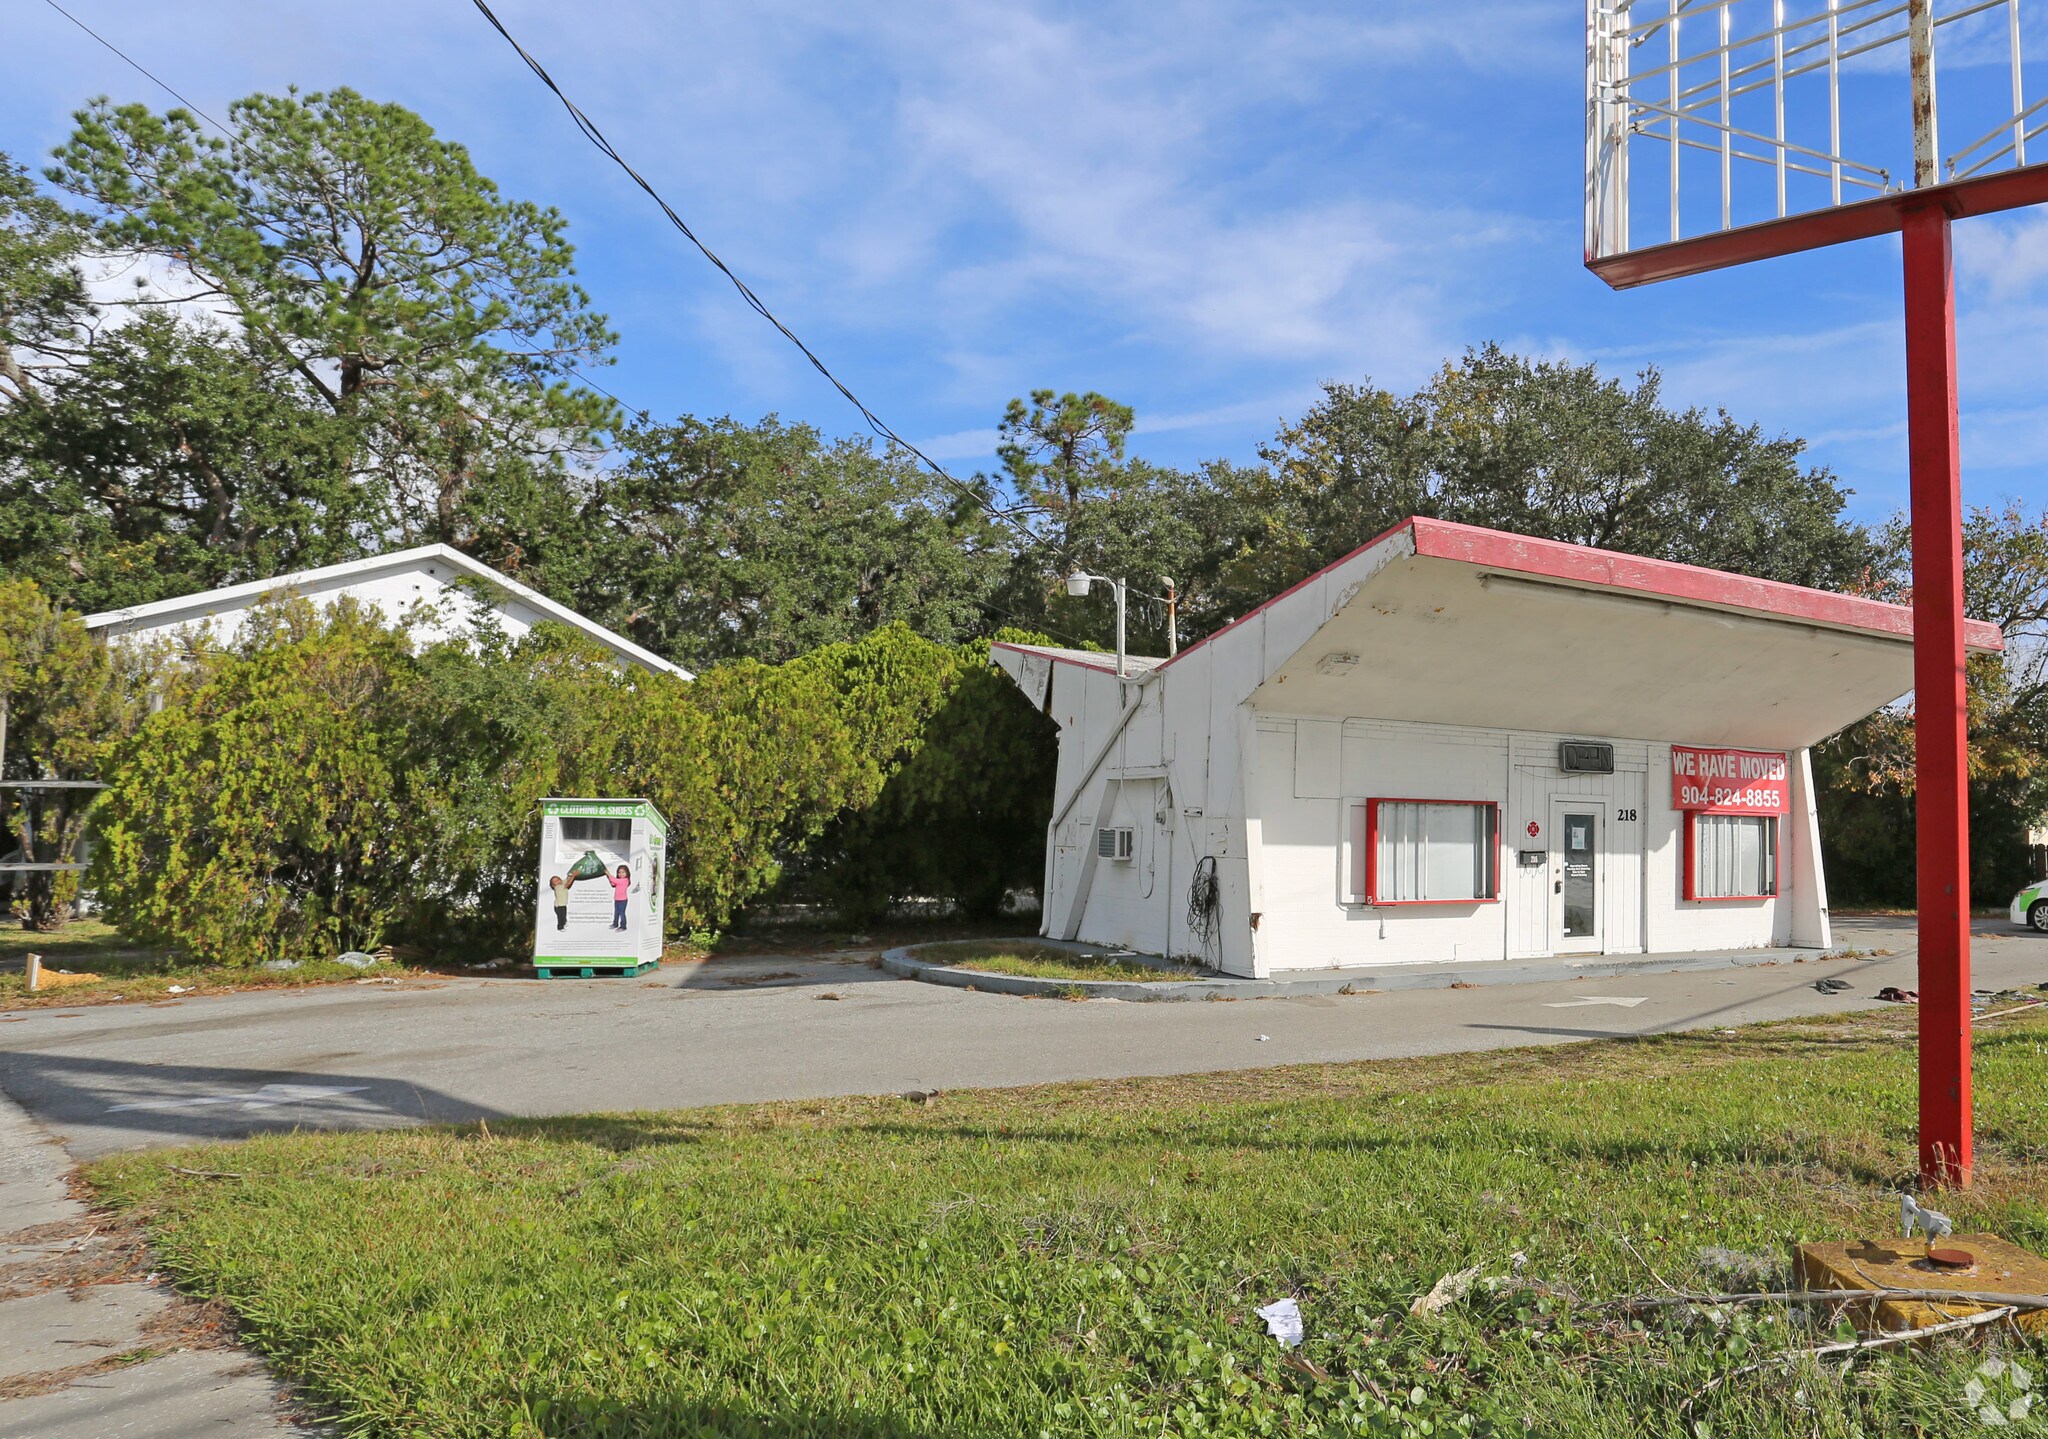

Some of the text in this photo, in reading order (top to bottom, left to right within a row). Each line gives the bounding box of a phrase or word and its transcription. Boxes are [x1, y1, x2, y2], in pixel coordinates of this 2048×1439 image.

[1673, 751, 1785, 781] WE HAVE MOVED
[1681, 785, 1780, 807] 904-824-8855
[560, 805, 633, 815] CLOTHING & SHOES
[1617, 808, 1637, 822] 218
